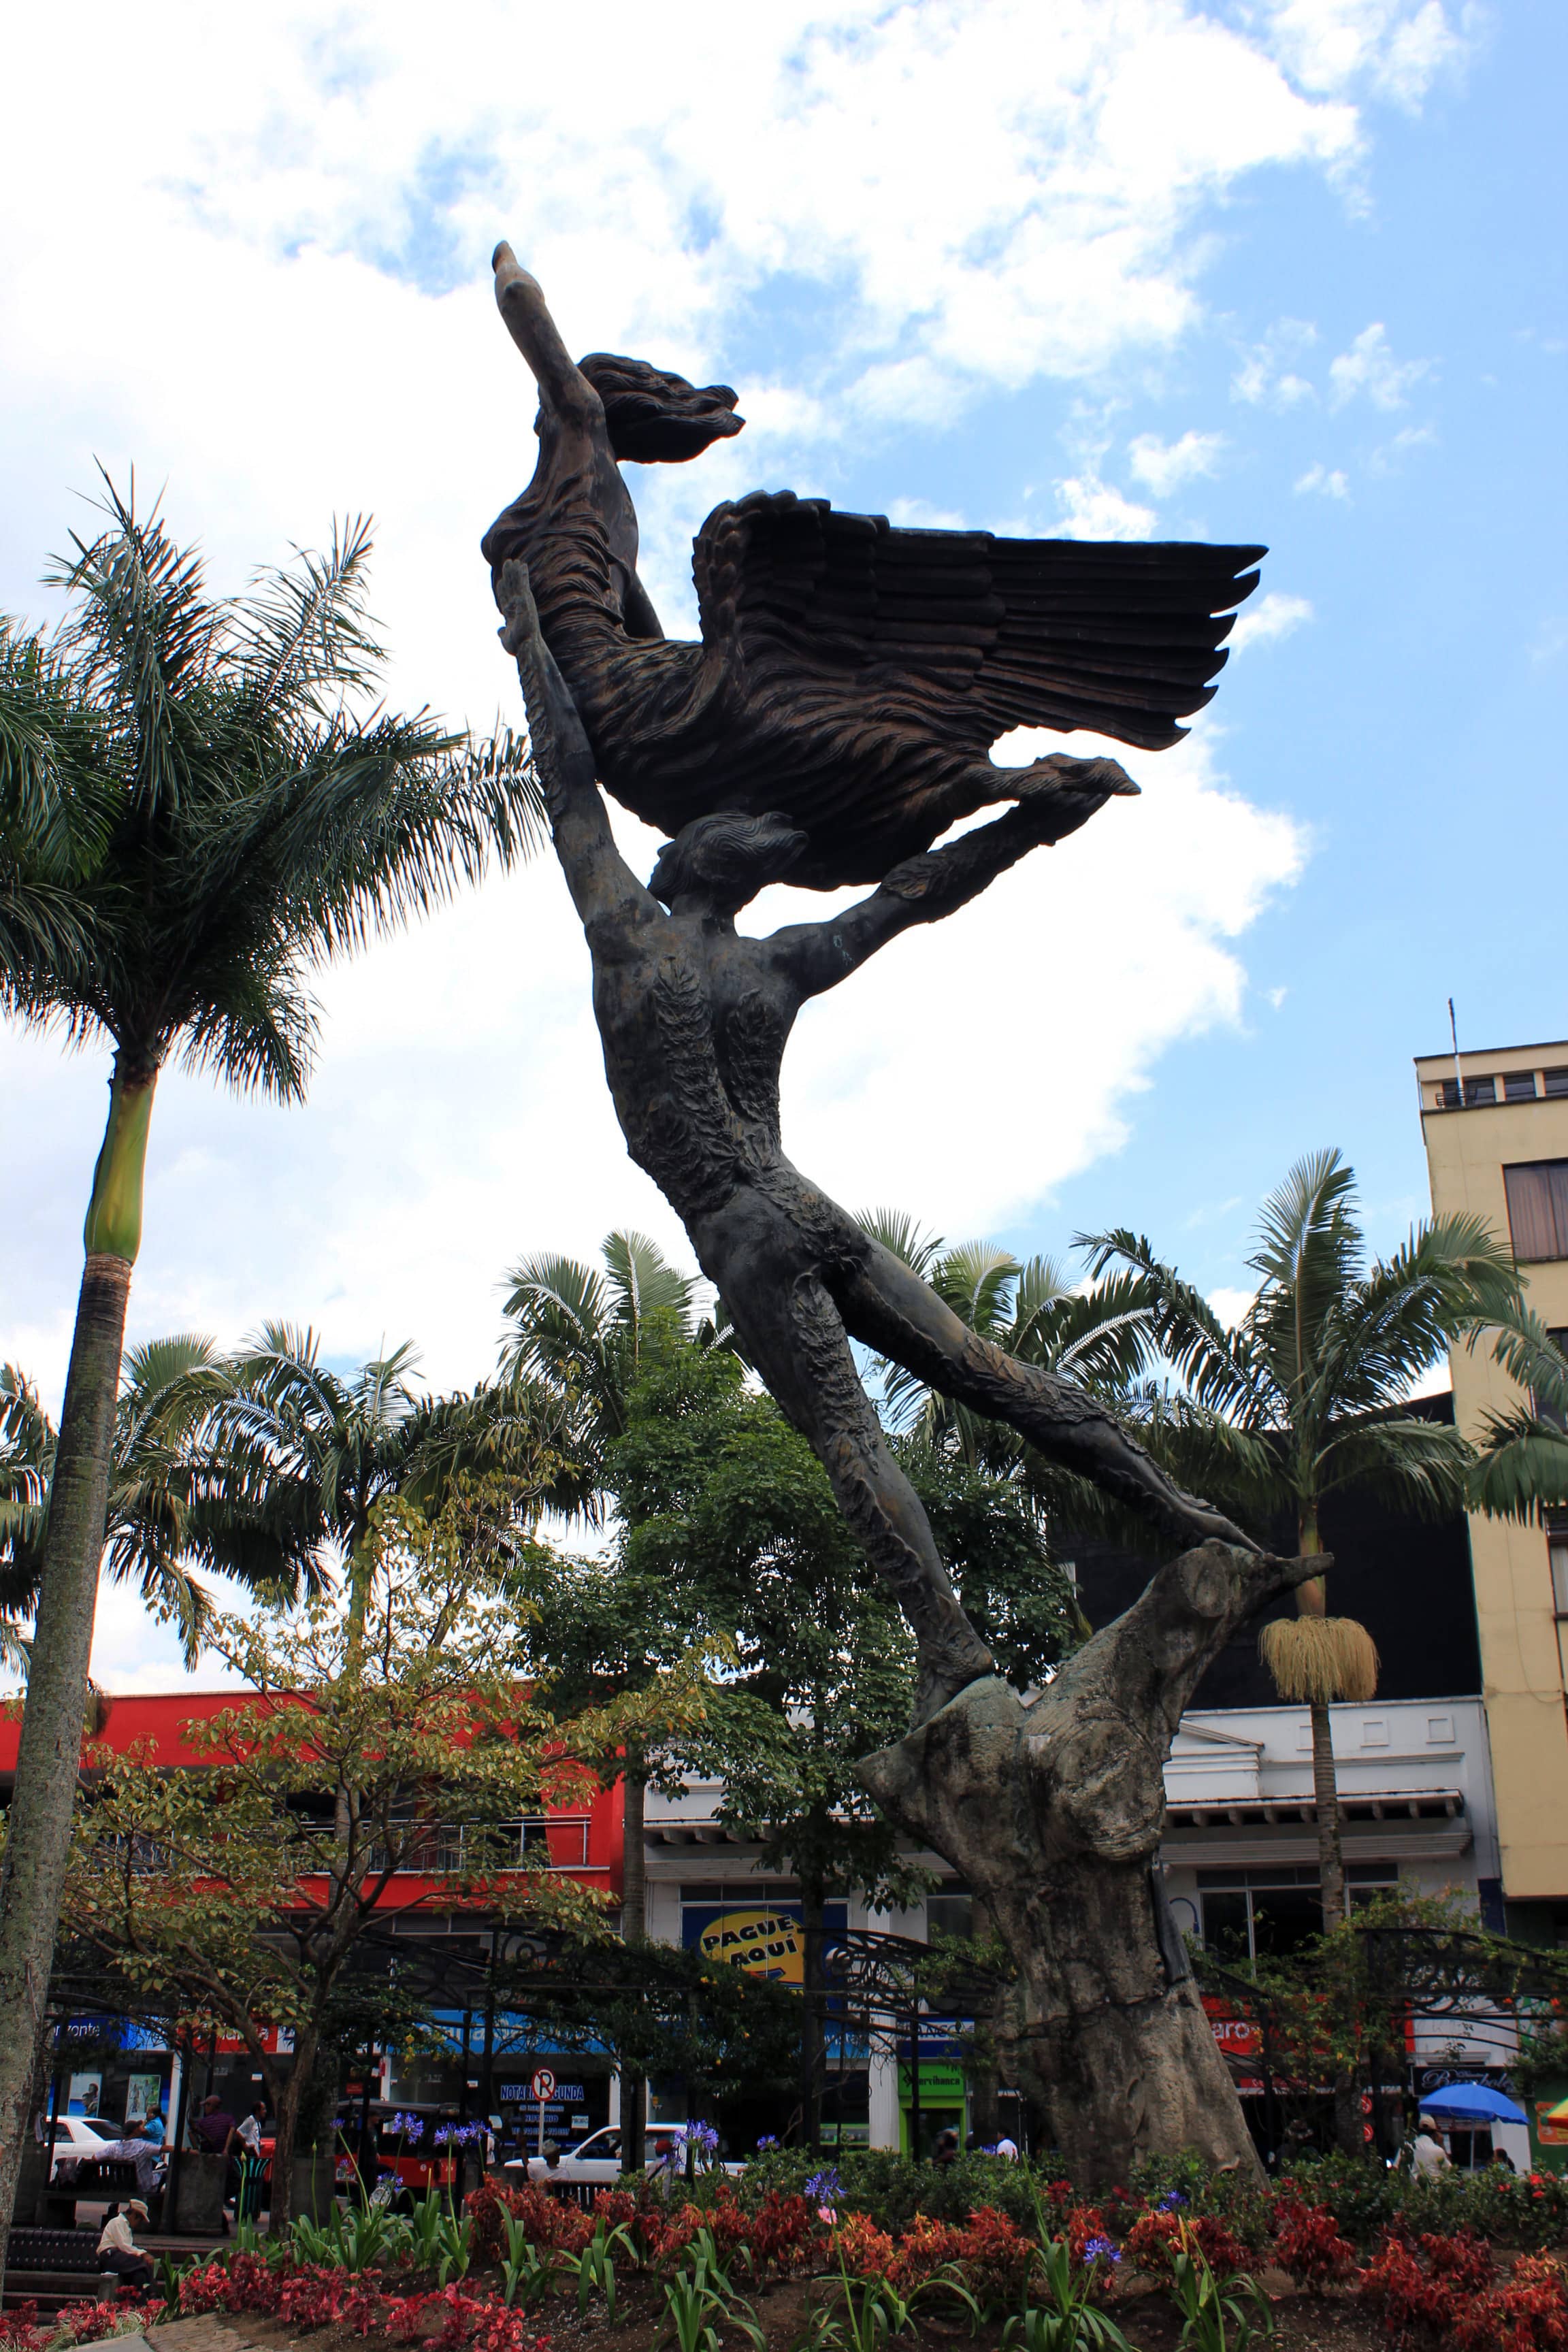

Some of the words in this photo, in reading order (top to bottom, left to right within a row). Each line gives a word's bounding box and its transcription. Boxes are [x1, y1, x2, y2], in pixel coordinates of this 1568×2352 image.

[702, 1914, 795, 1951] PAGUE
[730, 1933, 798, 1967] AQUÍ
[1211, 2022, 1250, 2040] aro
